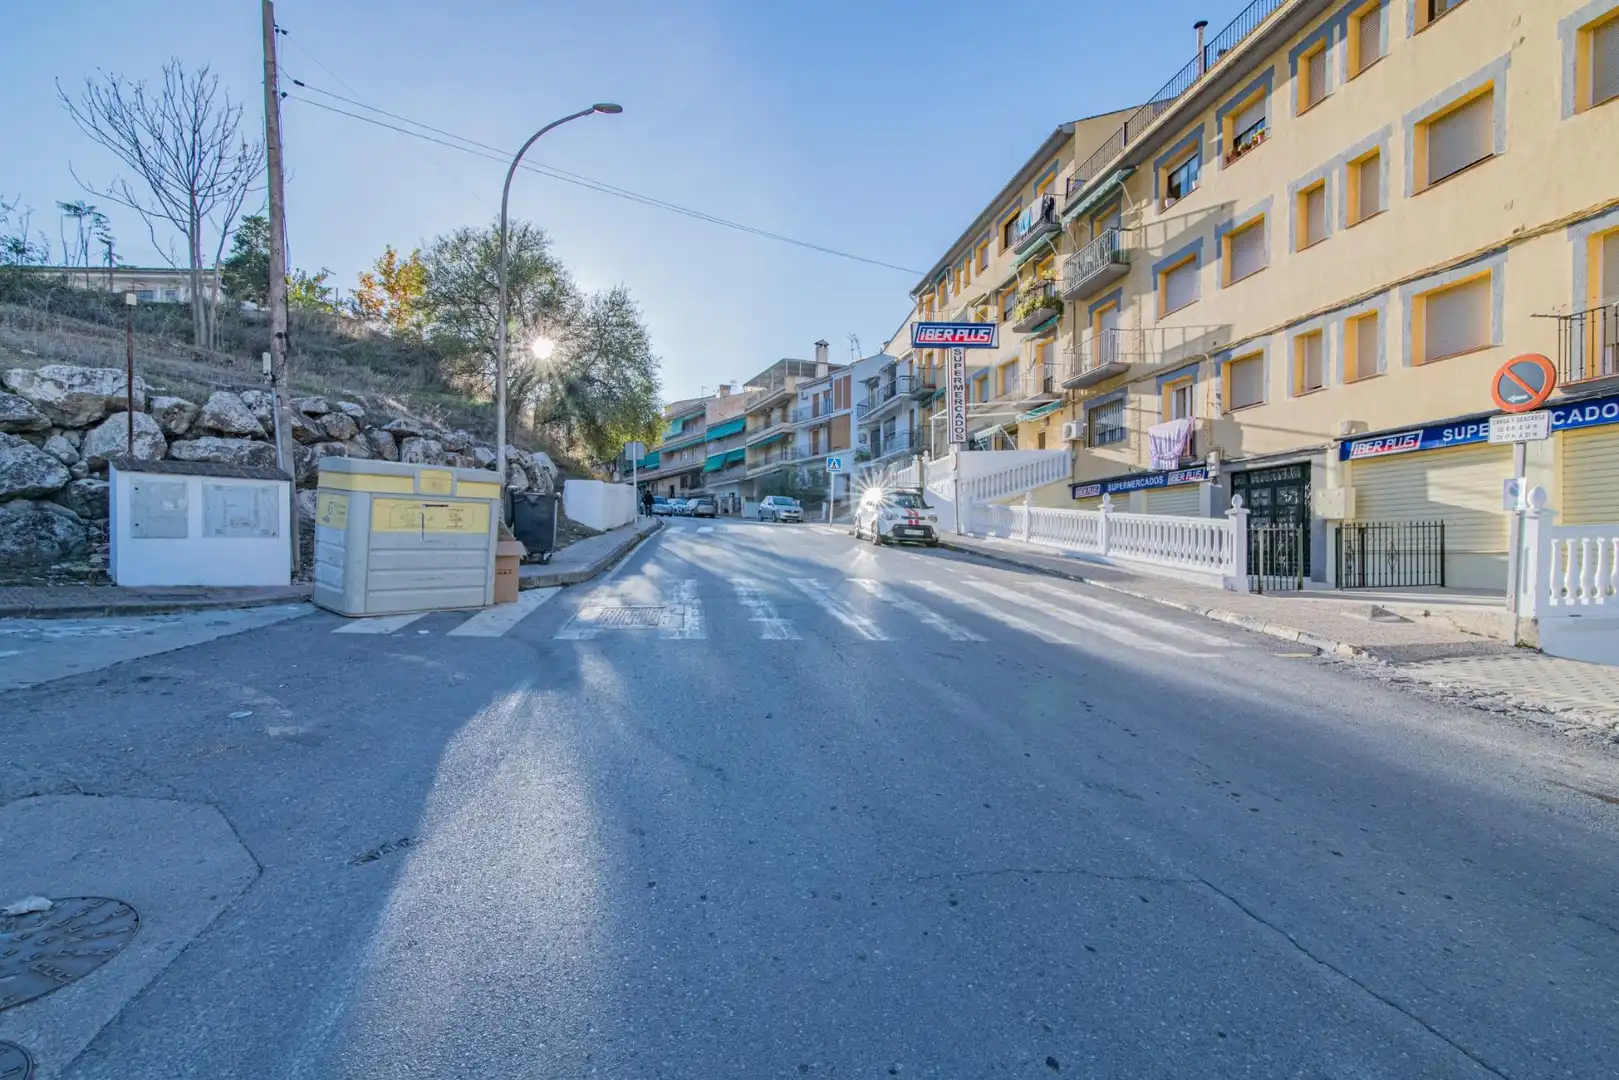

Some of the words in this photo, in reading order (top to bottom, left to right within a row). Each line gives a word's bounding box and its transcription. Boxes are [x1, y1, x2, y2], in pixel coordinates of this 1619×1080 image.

[955, 328, 990, 341] PLUS
[953, 348, 964, 441] SUPERMERCADOS
[1383, 435, 1415, 452] PLUS
[1107, 476, 1164, 492] SUPERMERCADOS
